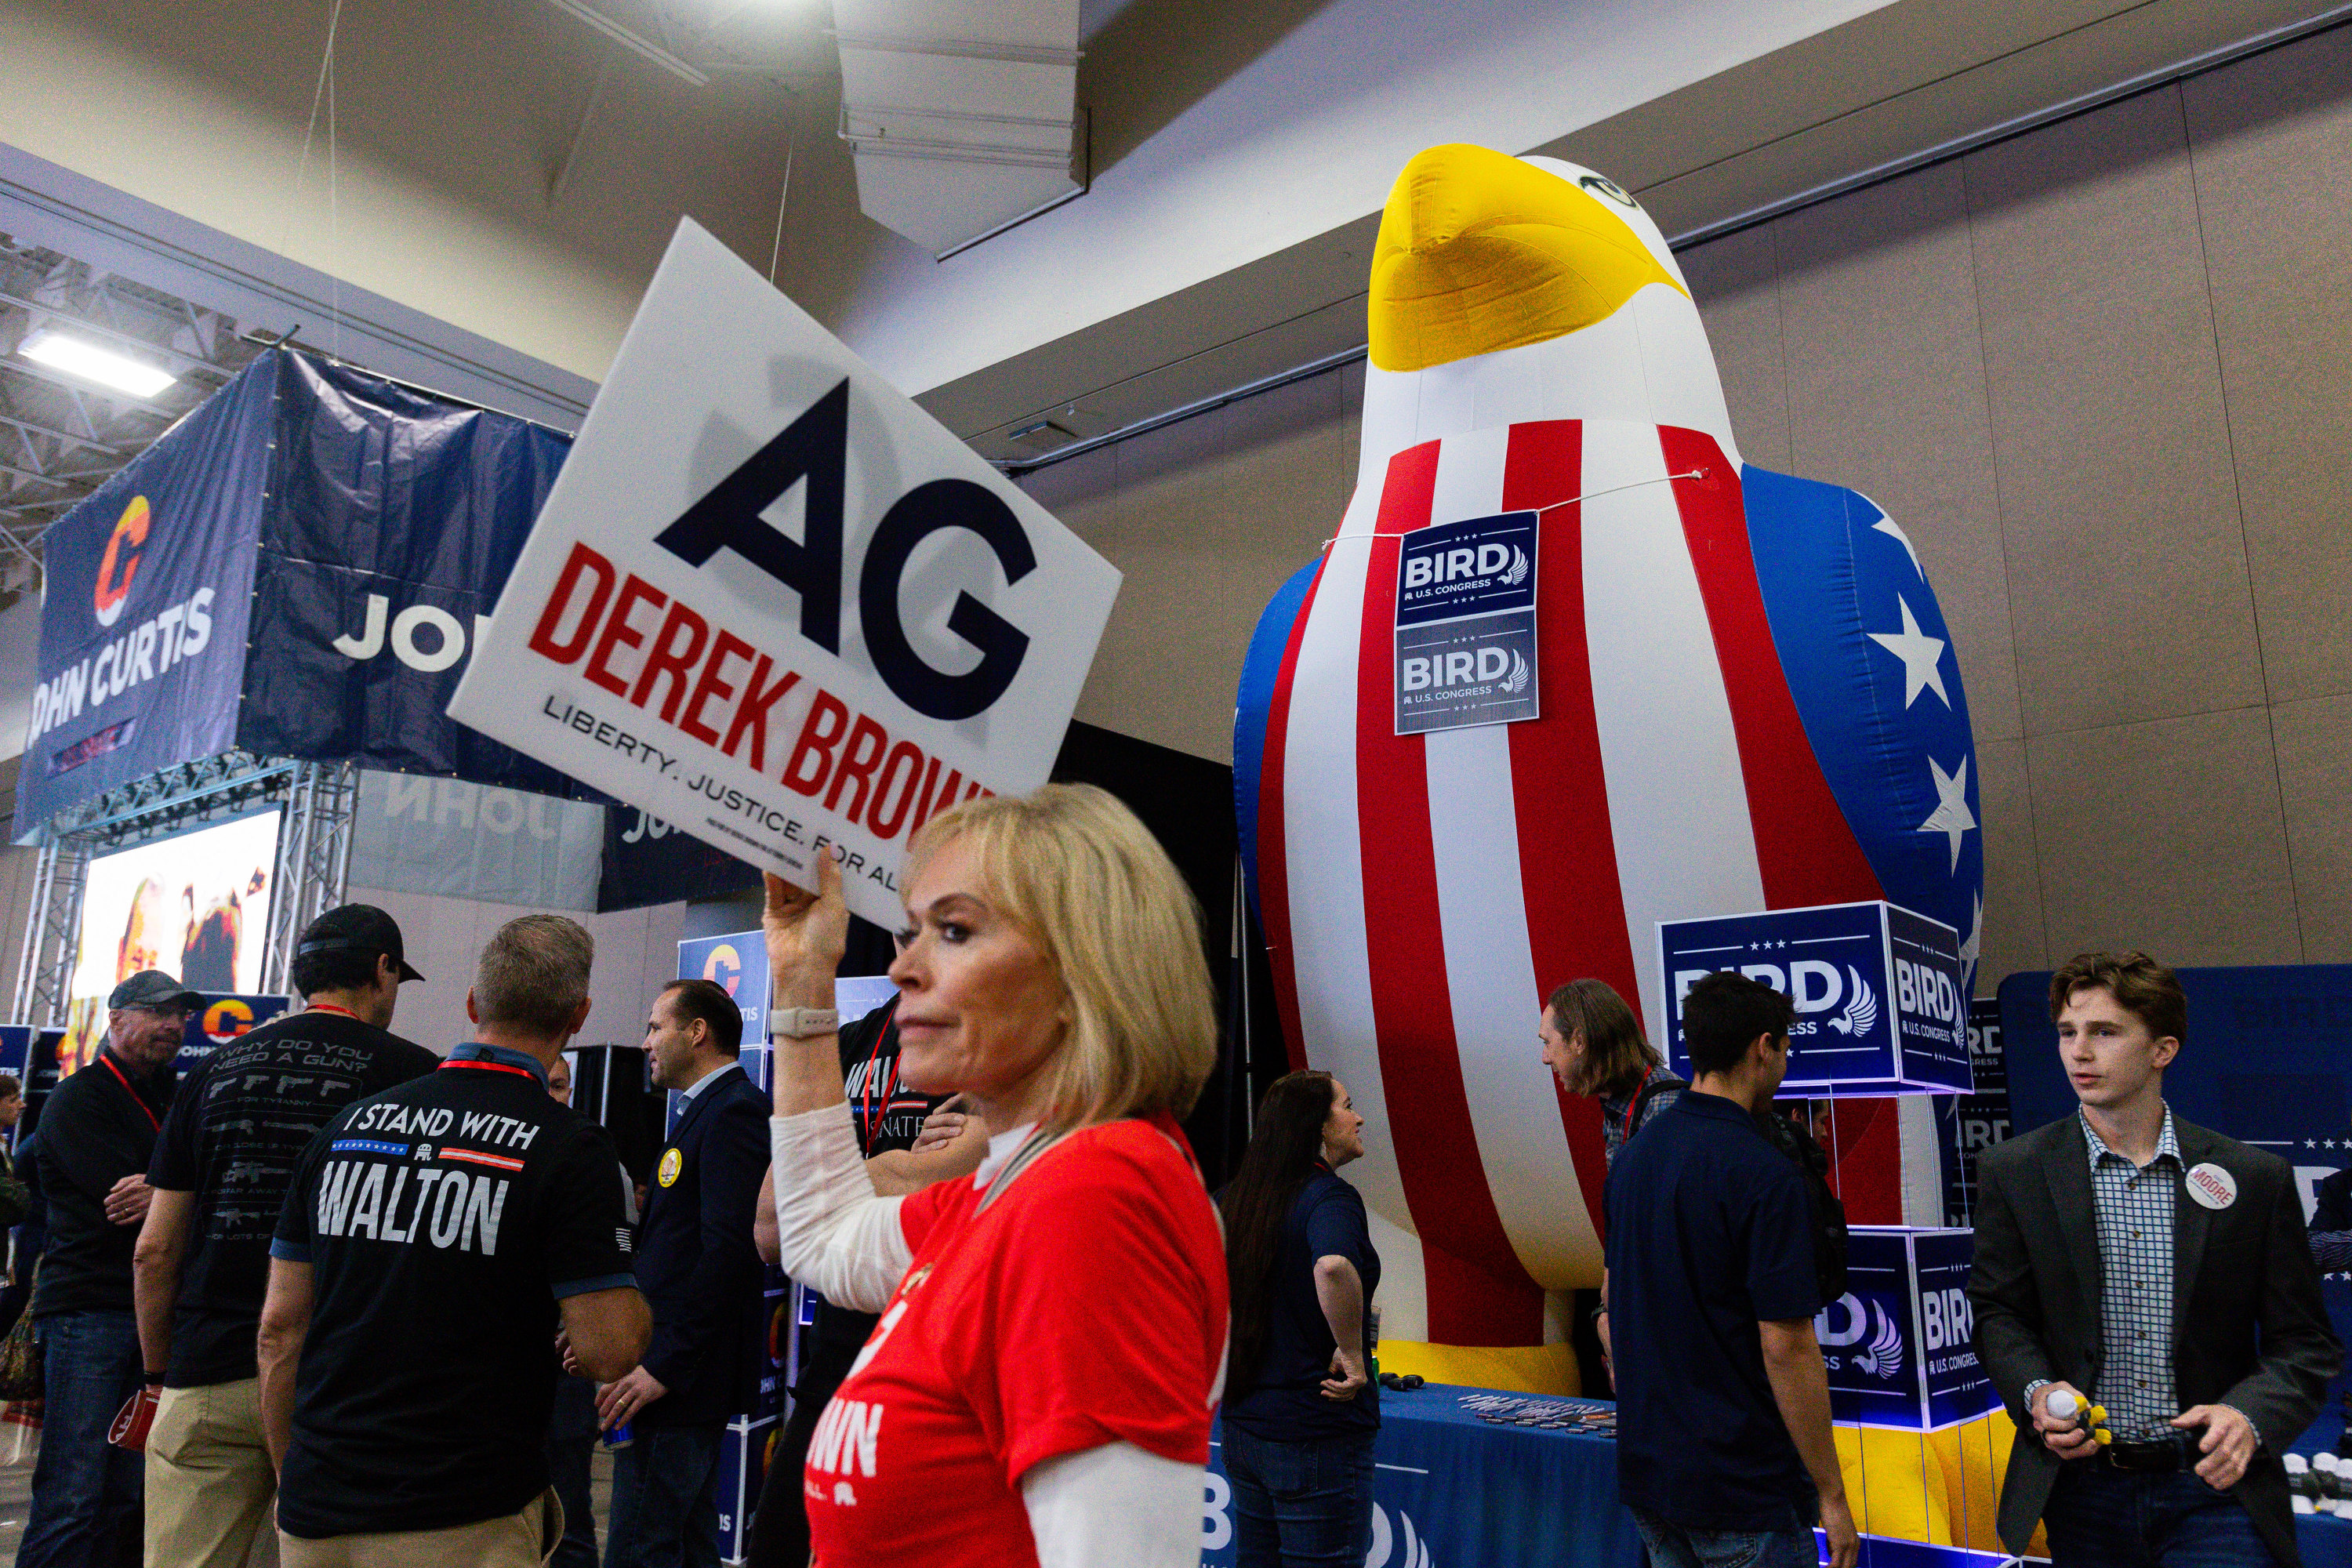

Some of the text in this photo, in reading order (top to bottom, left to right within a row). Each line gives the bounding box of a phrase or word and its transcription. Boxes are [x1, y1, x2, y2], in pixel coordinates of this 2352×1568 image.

[652, 376, 1037, 721] AG
[1405, 543, 1510, 589] BIRD
[1415, 579, 1491, 599] U.S. CONGRESS
[333, 593, 494, 673] JO
[27, 657, 91, 751] OHN
[91, 586, 215, 706] CURTIS
[1403, 647, 1509, 691] BIRD
[527, 541, 996, 853] DEREK BROW
[1415, 685, 1492, 703] U.S. CONGRESS
[543, 694, 680, 781] LIBERTY.
[688, 770, 805, 845] JUSTICE.
[868, 866, 898, 892] AL
[1896, 957, 1955, 1022] BIRD
[220, 1039, 374, 1061] WHY DO YOU
[1908, 1022, 1951, 1043] U.S. CONGRESS
[209, 1051, 368, 1074] NEED A GUN?
[343, 1103, 540, 1151] I STAND WITH
[318, 1160, 510, 1256] WALTON
[2190, 1168, 2234, 1205] MOORE
